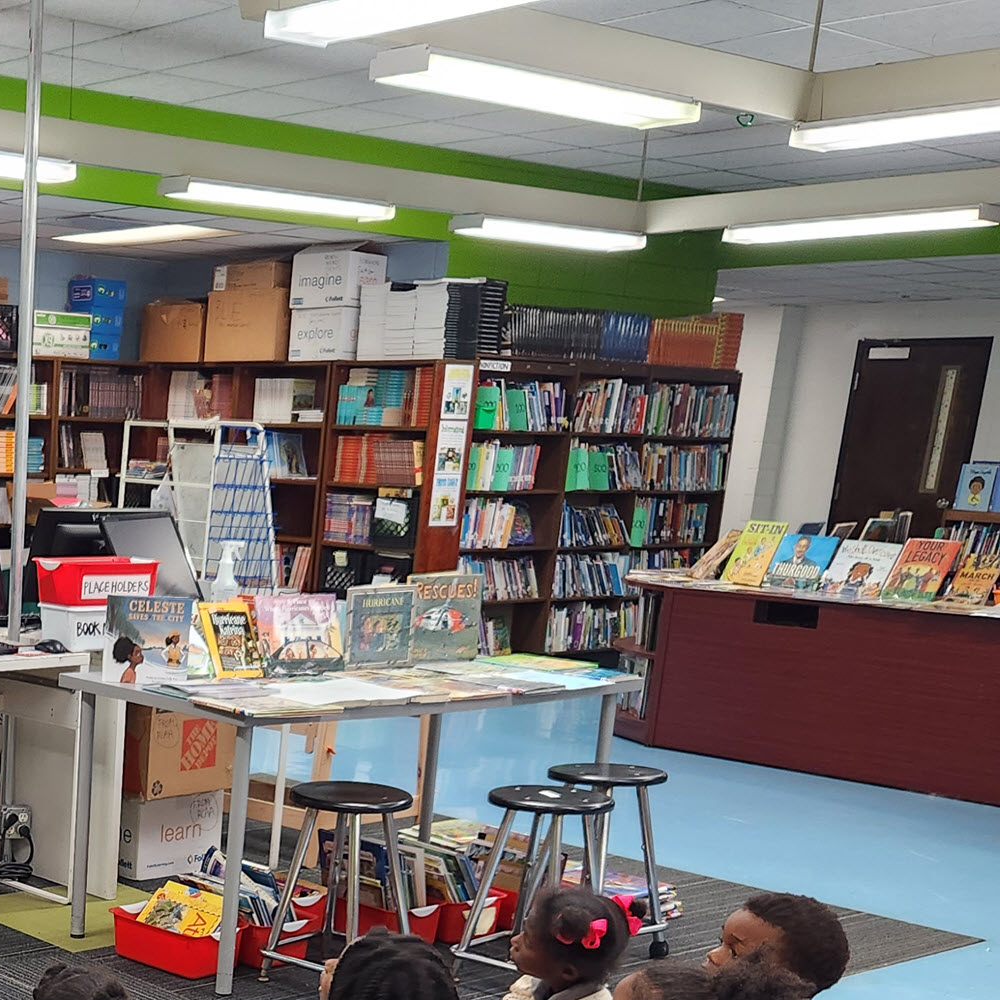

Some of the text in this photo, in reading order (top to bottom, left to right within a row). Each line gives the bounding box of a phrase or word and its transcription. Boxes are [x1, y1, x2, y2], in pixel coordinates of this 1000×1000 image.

[298, 274, 342, 289] imagine
[297, 327, 334, 342] explore
[747, 523, 785, 534] SIT-IN
[919, 541, 946, 551] YOUR
[905, 551, 948, 565] LEGACY
[772, 562, 821, 579] THURGOOD
[959, 571, 995, 581] MARCH
[416, 578, 478, 600] RESCUES!
[129, 599, 185, 614] CELESTE
[362, 597, 405, 608] HURRICANE
[129, 613, 148, 621] SAVES
[167, 615, 184, 623] CITY
[76, 621, 101, 637] BOOK
[181, 719, 218, 771] HOME
[160, 822, 201, 843] learn
